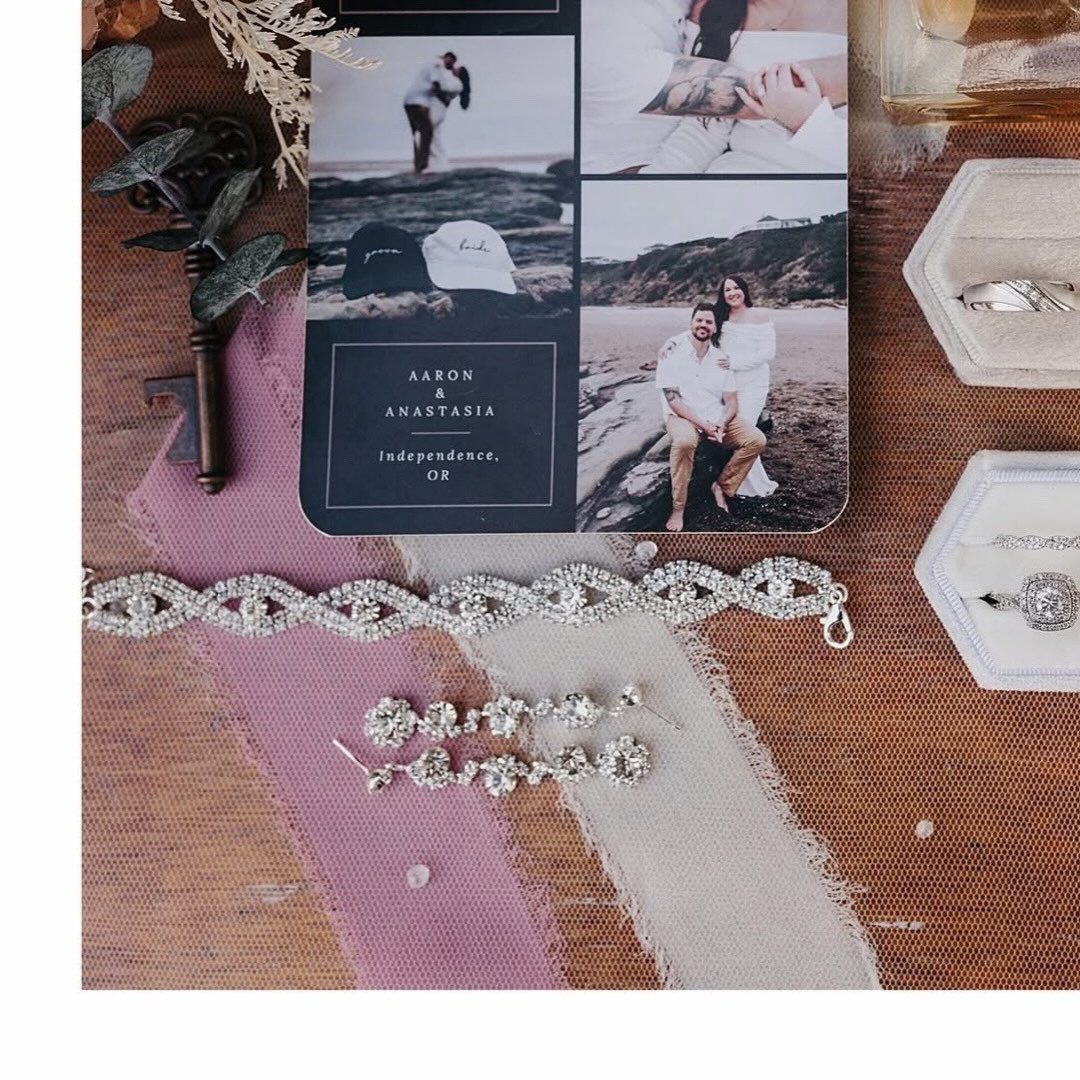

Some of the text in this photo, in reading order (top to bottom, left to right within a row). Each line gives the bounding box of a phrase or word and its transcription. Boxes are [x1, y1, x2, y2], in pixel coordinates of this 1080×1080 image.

[408, 369, 473, 381] AARON
[435, 387, 446, 399] &
[385, 405, 494, 417] ANASTASIA
[379, 449, 499, 464] Independence,
[427, 469, 450, 481] OR
